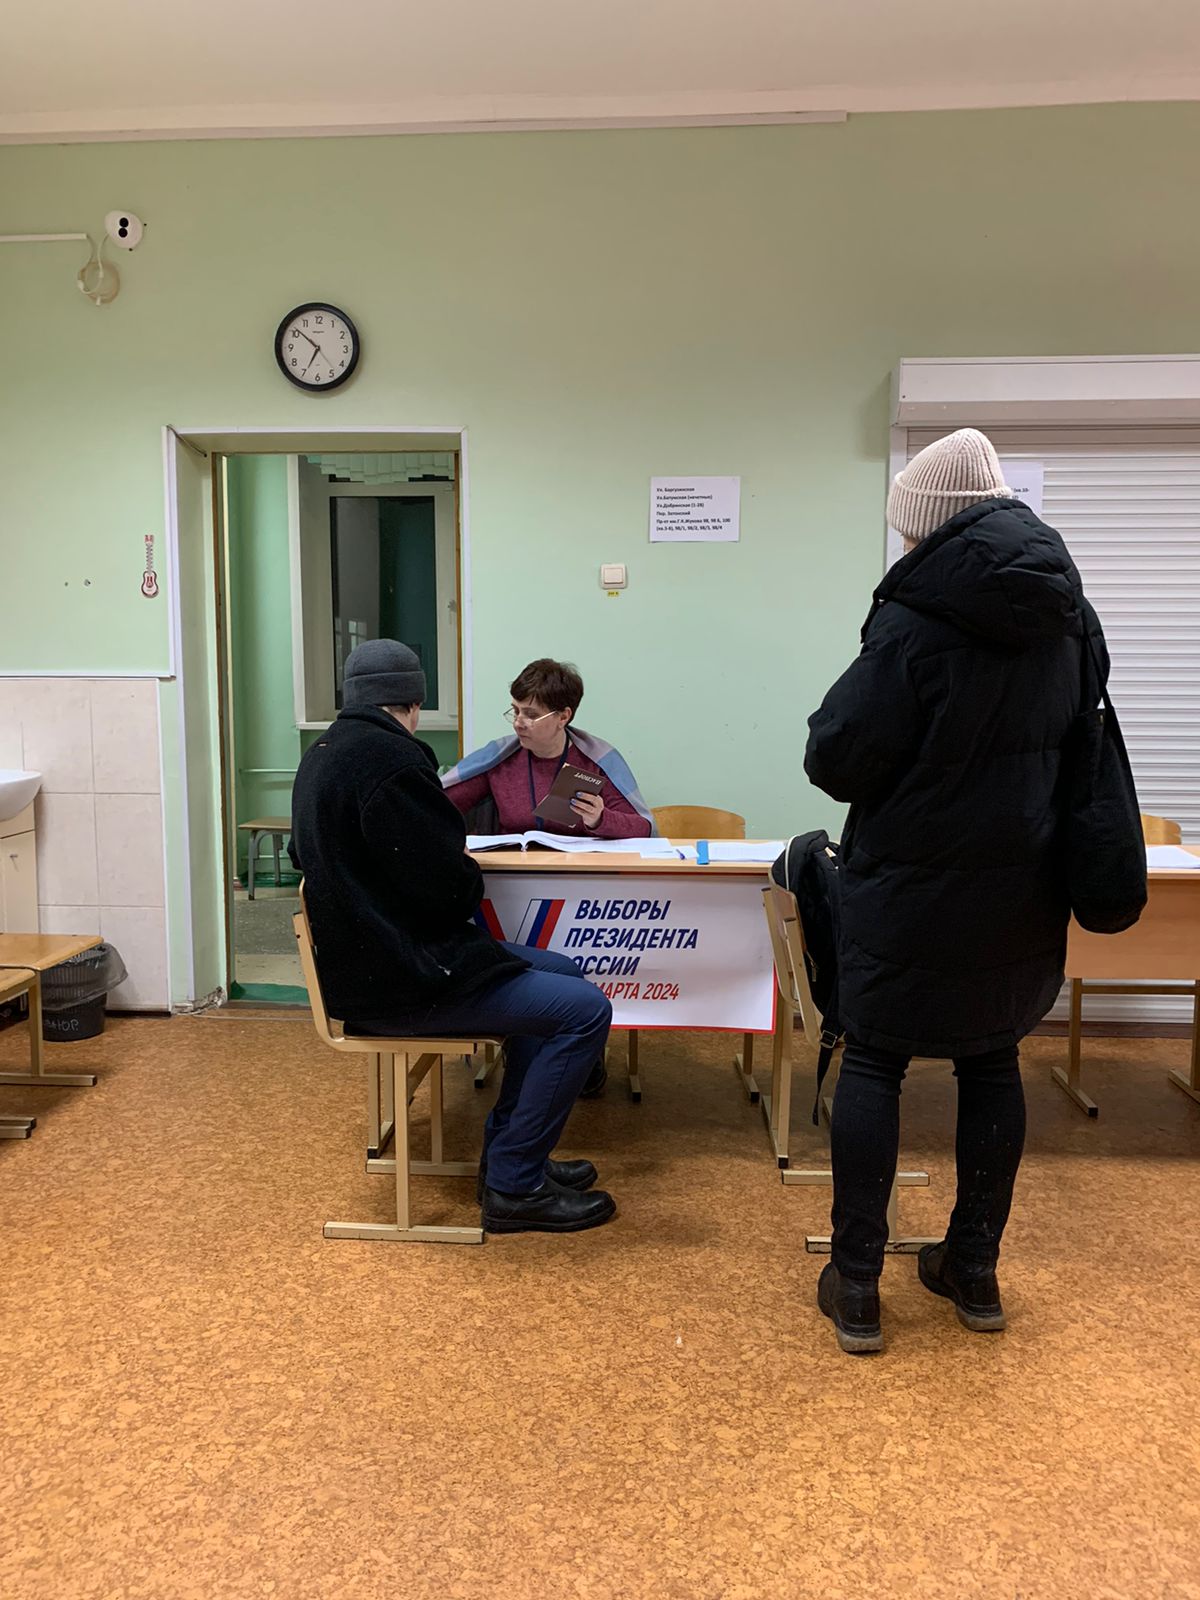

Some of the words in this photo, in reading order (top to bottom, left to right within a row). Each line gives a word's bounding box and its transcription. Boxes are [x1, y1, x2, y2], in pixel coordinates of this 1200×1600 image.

[302, 320, 308, 328] 11
[315, 316, 323, 324] 12
[291, 330, 300, 338] 10
[340, 331, 345, 340] 2
[288, 344, 294, 352] 9
[343, 345, 348, 354] 3
[292, 358, 297, 366] 8
[339, 360, 344, 368] 4
[302, 368, 307, 376] 7
[329, 370, 334, 378] 5
[315, 373, 320, 382] 6
[574, 900, 672, 920] ВЫБОРЫ
[564, 928, 698, 952] ПРЕЗИДЕНТА
[572, 956, 641, 976] ОССИИ
[642, 982, 680, 1000] 2024
